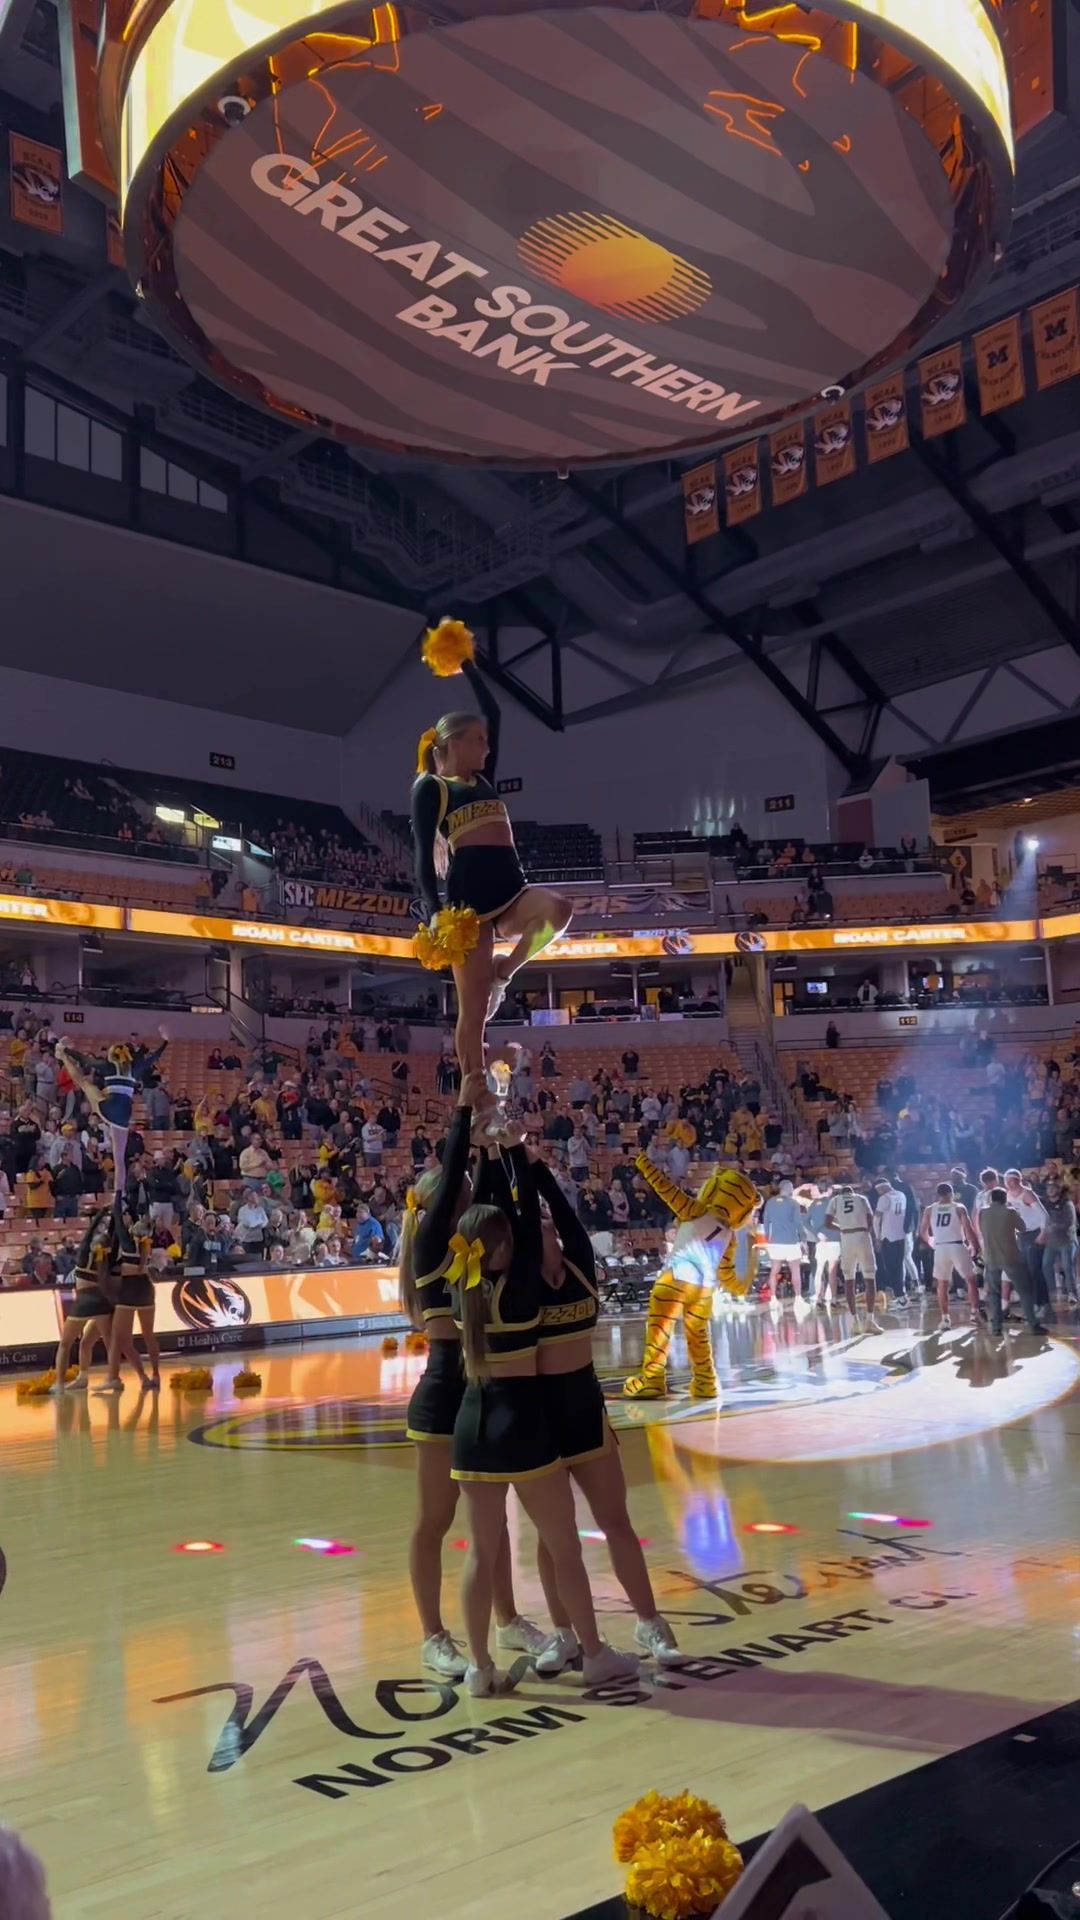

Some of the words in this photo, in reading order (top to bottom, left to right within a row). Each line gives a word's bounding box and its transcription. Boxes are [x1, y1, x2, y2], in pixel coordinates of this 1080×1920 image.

[250, 153, 489, 289] GREAT
[475, 286, 761, 422] SOUTHERN
[395, 295, 581, 387] BANK
[769, 798, 791, 810] 211
[315, 886, 409, 916] MIZZOU
[232, 925, 285, 941] NOAH
[289, 930, 354, 948] CARTER
[834, 932, 887, 944] NOAH
[893, 928, 965, 941] CARTER
[545, 942, 617, 956] CARTER
[844, 1200, 854, 1214] 5
[936, 1212, 951, 1227] 10
[705, 1226, 722, 1242] 1
[189, 1334, 219, 1346] Health
[13, 1351, 38, 1363] Care
[292, 1704, 588, 1799] NORM
